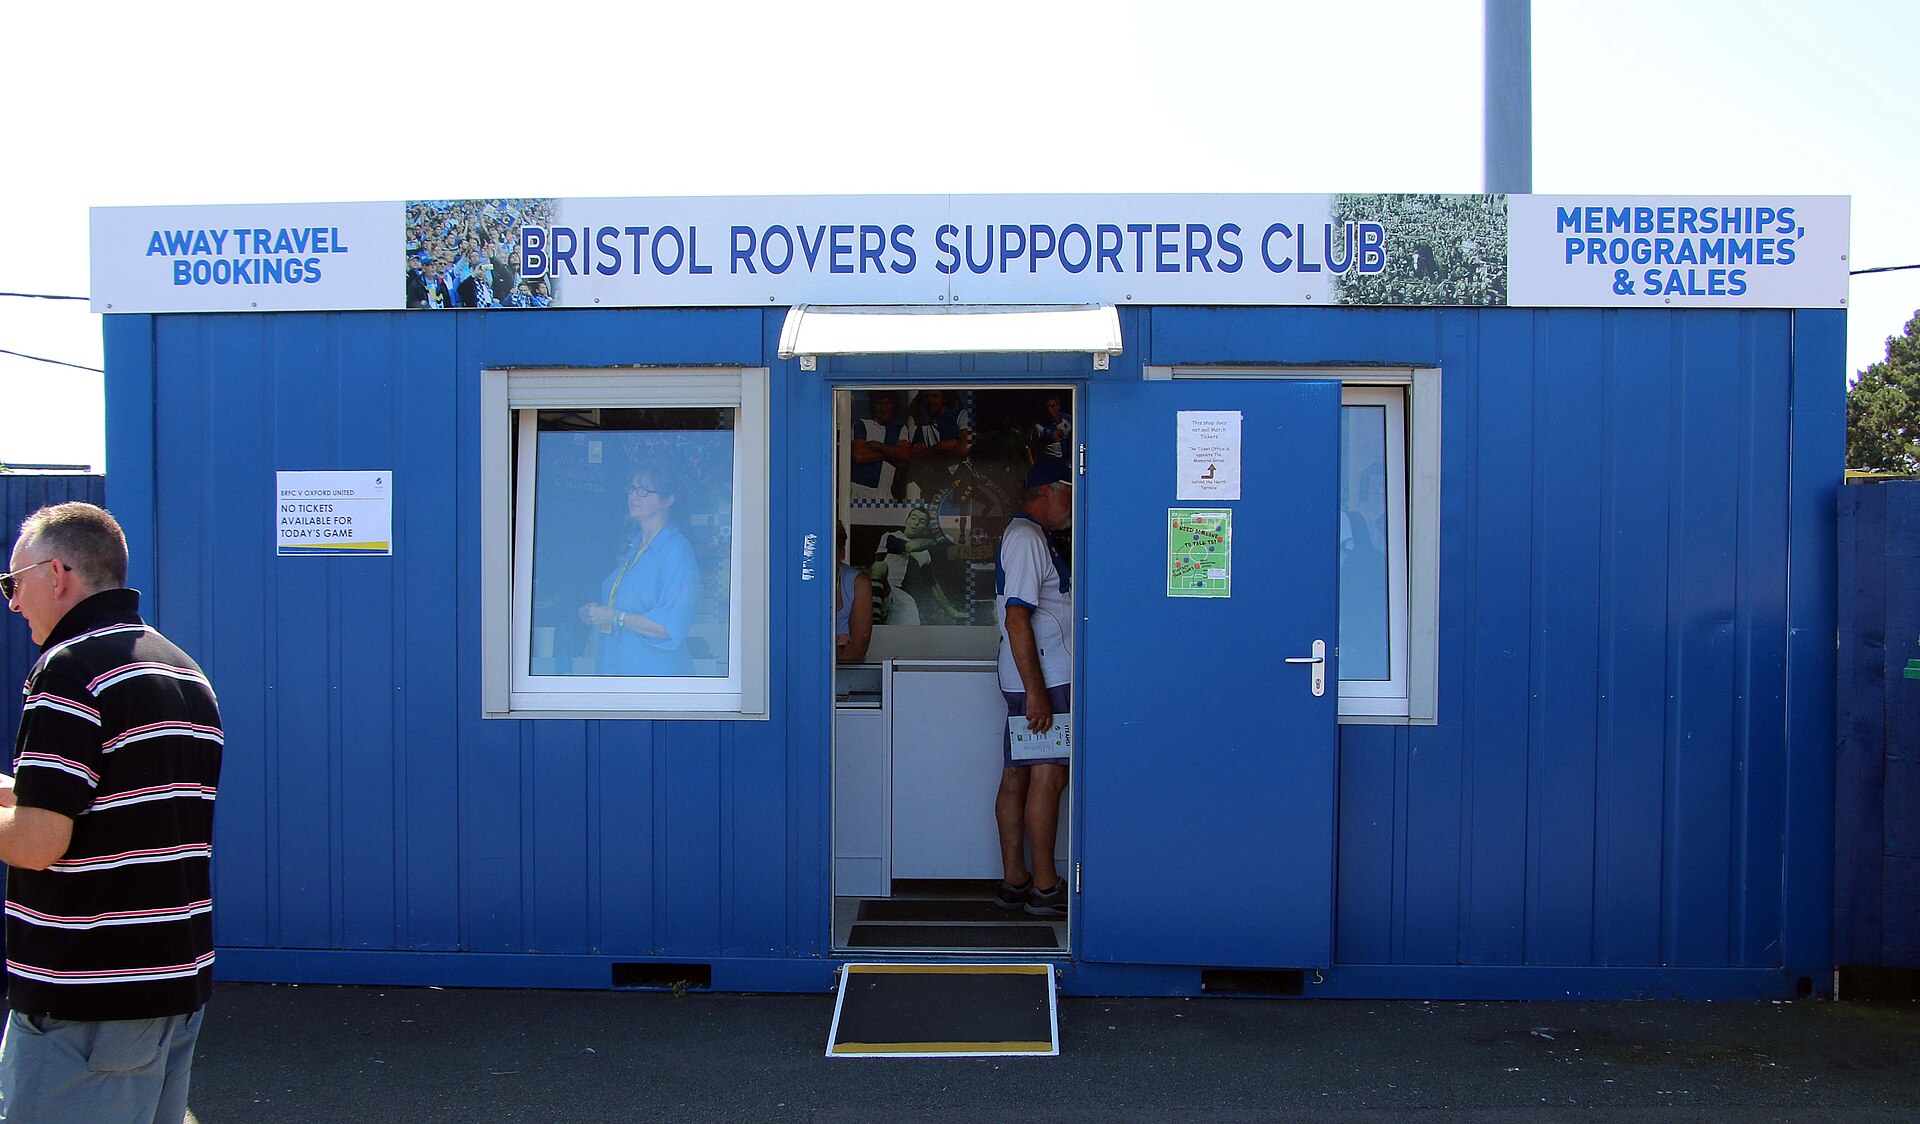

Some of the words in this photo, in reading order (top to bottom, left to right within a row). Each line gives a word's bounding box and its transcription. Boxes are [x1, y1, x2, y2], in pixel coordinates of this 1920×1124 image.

[1555, 205, 1806, 240] MEMBERSHIPS,
[147, 229, 230, 256] AWAY
[233, 227, 348, 254] TRAVEL
[521, 225, 713, 278] BRISTOL
[730, 224, 917, 276] ROVERS
[934, 221, 1244, 275] SUPPORTERS
[1260, 220, 1386, 275] CLUB
[1564, 238, 1797, 266] PROGRAMMES
[173, 257, 322, 285] BOOKINGS
[1611, 269, 1636, 296] &
[1642, 268, 1748, 296] SALES
[281, 504, 296, 513] NO
[299, 504, 333, 513] TICKETS
[281, 516, 331, 525] AVAILABLE
[334, 516, 352, 525] FOR
[281, 529, 321, 538] TODAY'S
[323, 529, 353, 538] GAME
